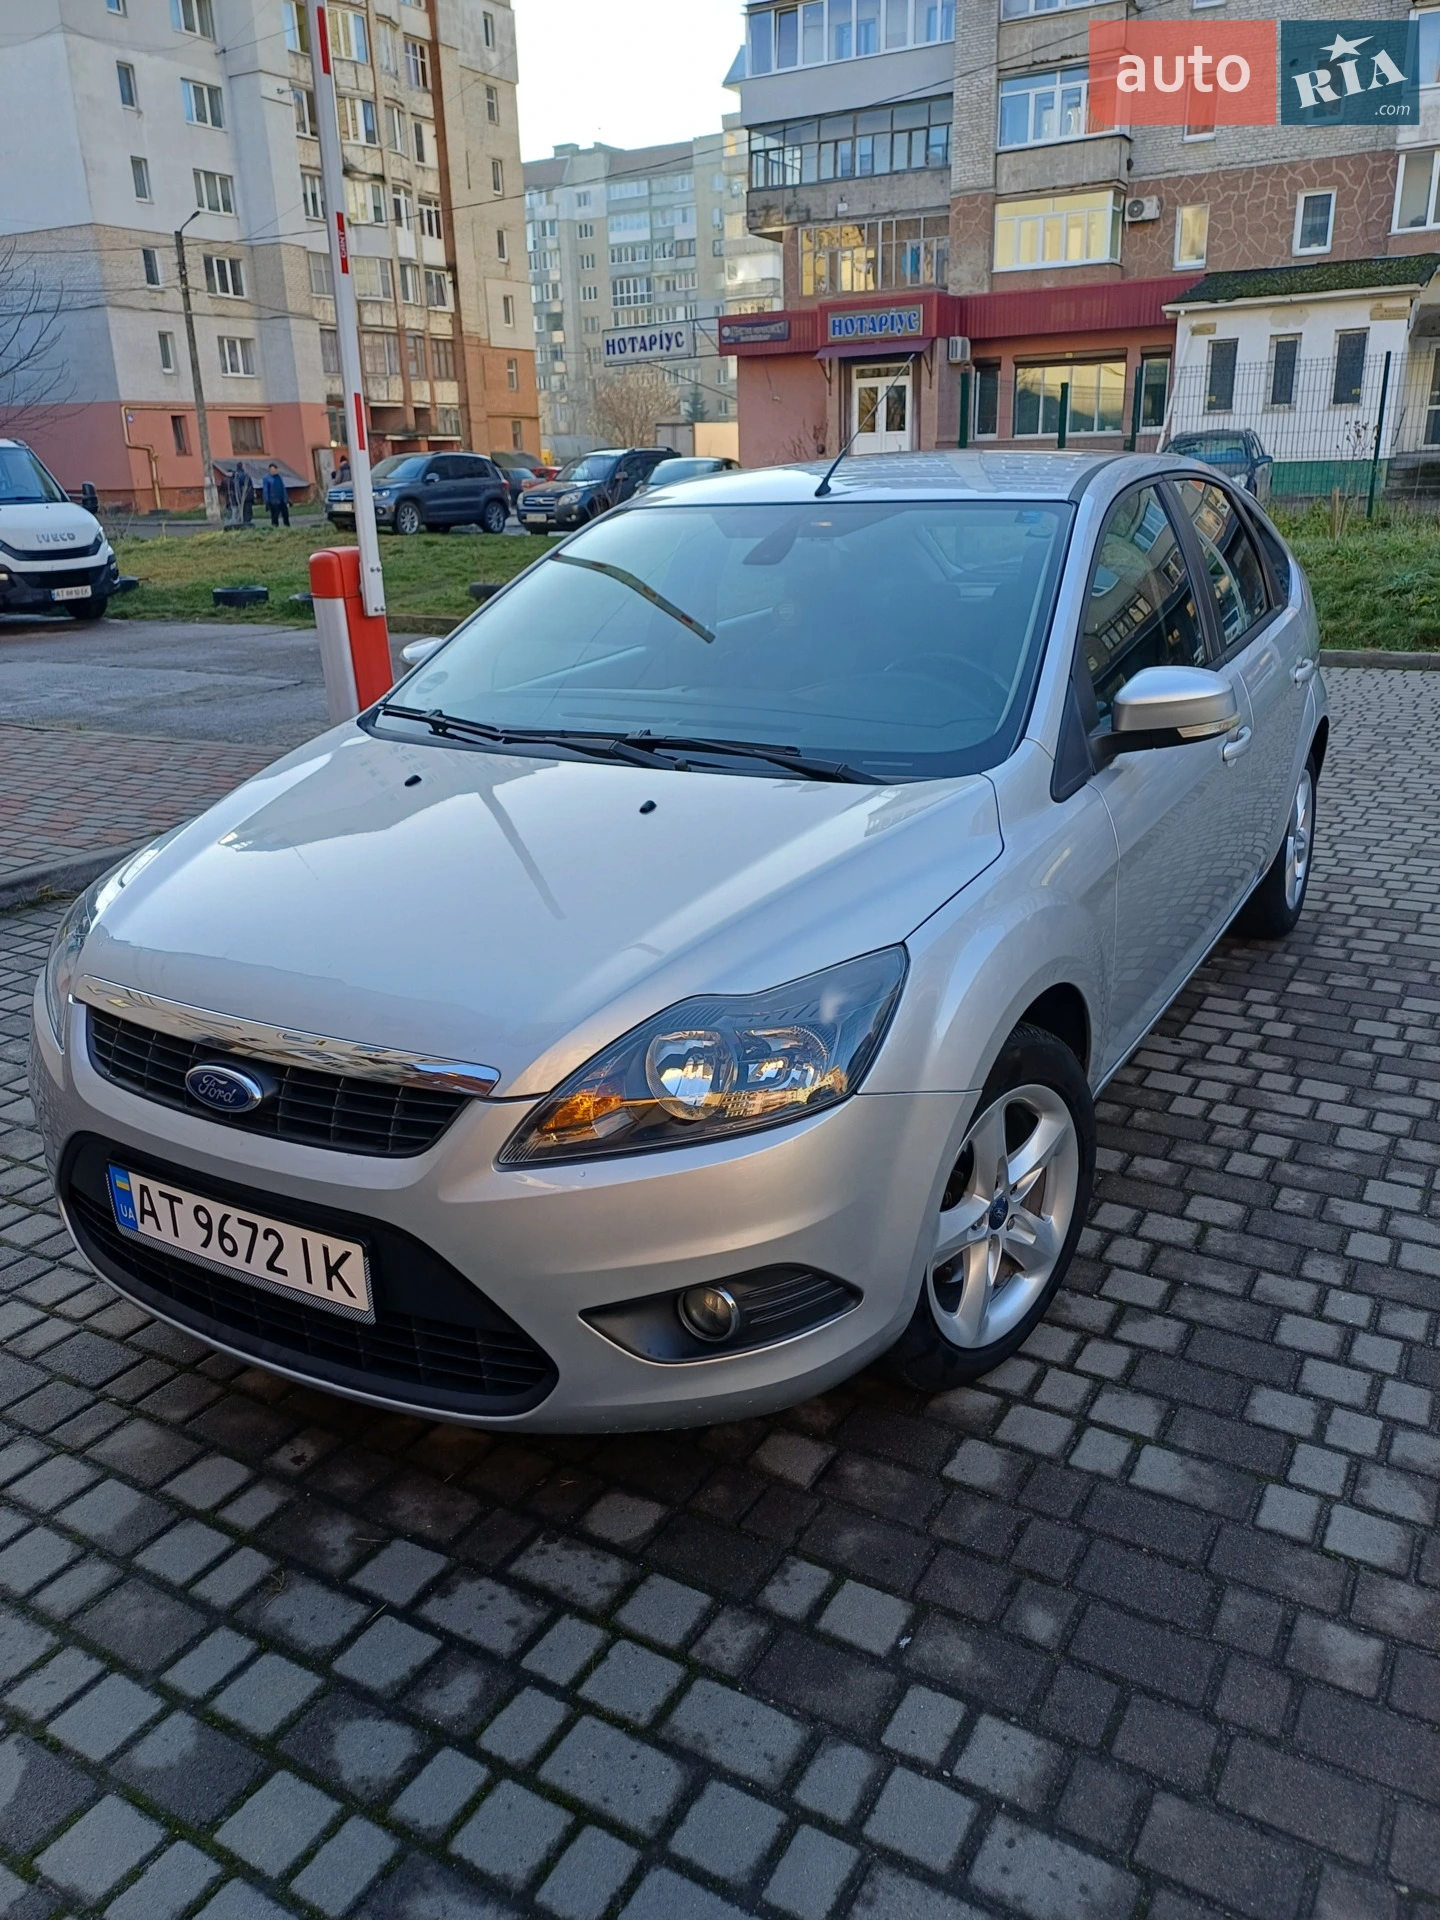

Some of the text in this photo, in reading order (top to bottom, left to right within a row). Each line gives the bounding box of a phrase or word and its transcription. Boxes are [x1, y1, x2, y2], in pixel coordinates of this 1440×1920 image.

[831, 308, 919, 338] НОТАРІУС
[605, 330, 685, 356] НОТАРІУС
[36, 532, 76, 544] IVECO
[198, 1074, 237, 1103] Ford
[120, 1203, 136, 1221] UA
[138, 1183, 358, 1299] AT 9672 IK
